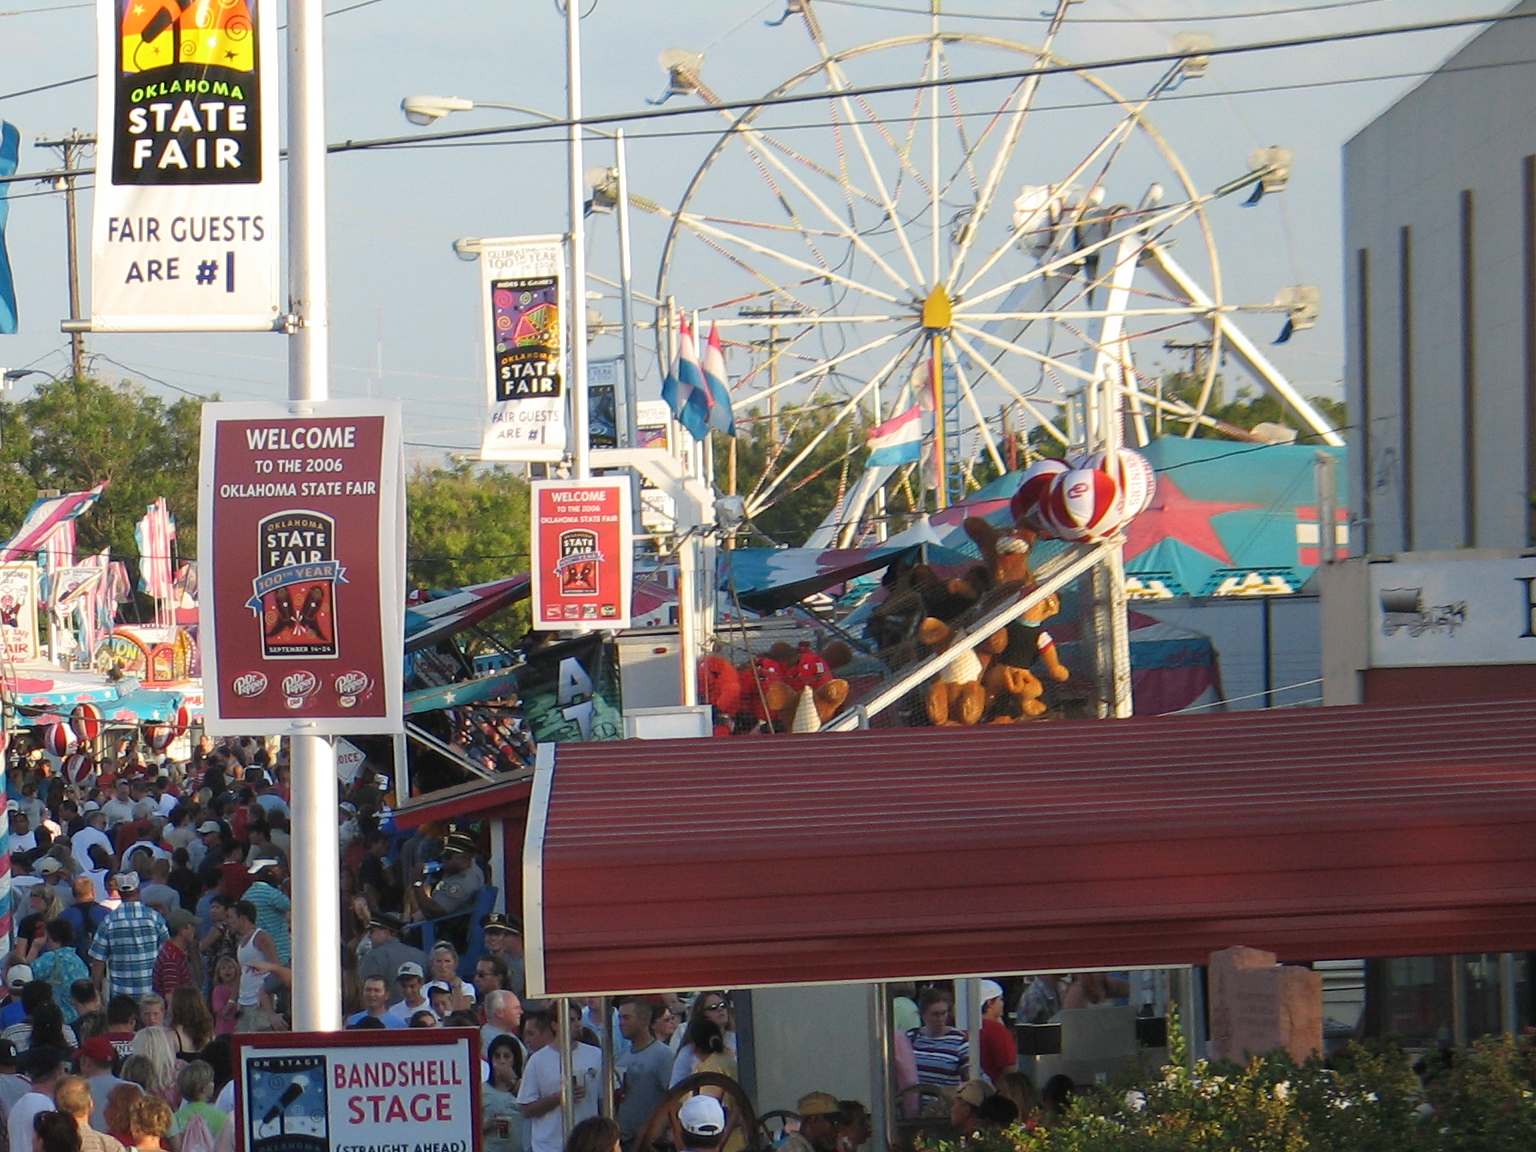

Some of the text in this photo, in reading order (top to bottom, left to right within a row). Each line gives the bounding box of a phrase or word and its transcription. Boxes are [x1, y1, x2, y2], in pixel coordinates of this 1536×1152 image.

[130, 79, 245, 103] OKLAHOMA
[128, 100, 248, 134] STATE
[132, 138, 242, 170] FAIR
[108, 215, 265, 243] FAIR GUESTS
[125, 251, 235, 293] ARE #1
[501, 361, 557, 379] STATE
[505, 377, 554, 395] FAIR
[492, 409, 560, 424] FAIR GUESTS
[246, 426, 357, 451] WELCOME
[497, 425, 546, 445] ARE #1
[255, 458, 343, 474] TO THE 2006
[220, 480, 376, 499] OKLAHOMA STATE FAIR
[551, 491, 607, 502] WELCOME
[557, 505, 567, 513] TO
[267, 520, 325, 532] OKLAHOMA
[580, 515, 601, 523] STATE
[267, 530, 326, 549] STATE
[563, 538, 593, 547] STATE
[270, 551, 324, 567] FAIR
[565, 547, 593, 555] FAIR
[295, 565, 334, 579] YEAR
[253, 1058, 320, 1068] ON STAGE
[334, 1060, 463, 1089] BANDSHELL
[347, 1093, 453, 1125] STAGE
